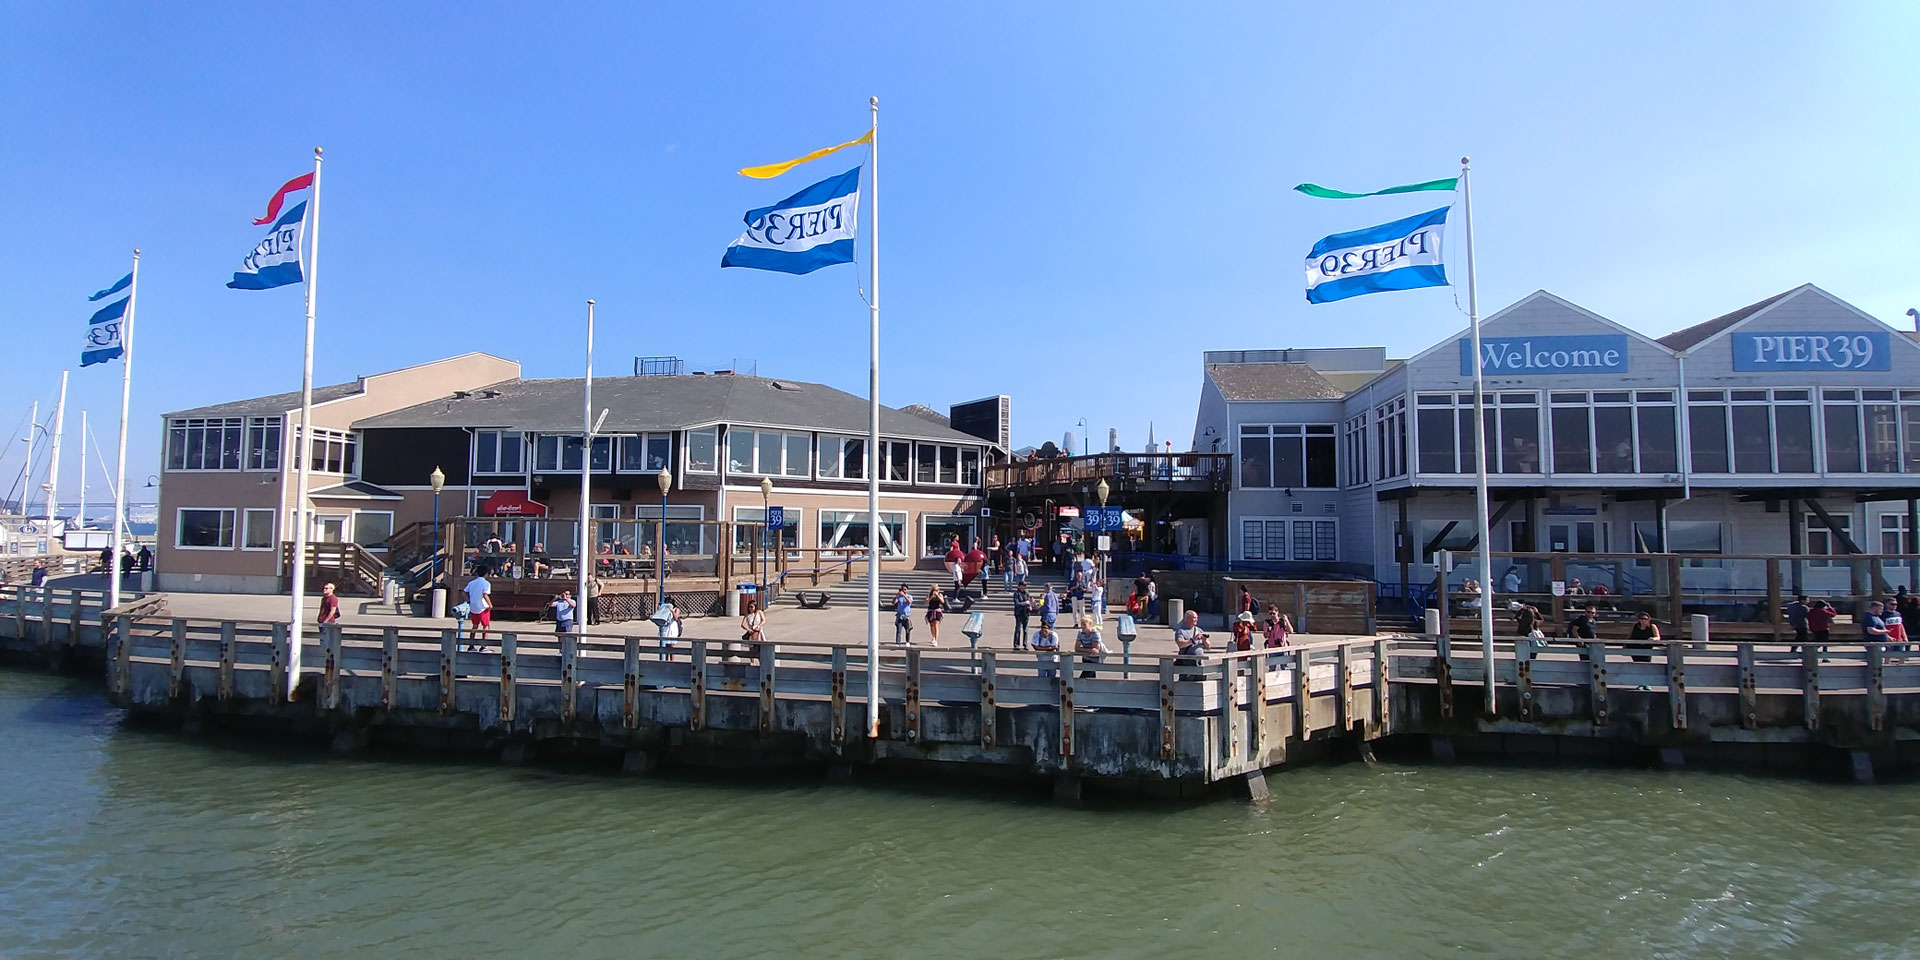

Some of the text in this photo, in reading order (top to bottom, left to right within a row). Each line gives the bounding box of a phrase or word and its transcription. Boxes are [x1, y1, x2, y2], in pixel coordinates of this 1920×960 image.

[1471, 341, 1621, 369] Welcome
[770, 515, 782, 526] 39
[1086, 515, 1100, 526] 39
[1106, 515, 1121, 527] 39
